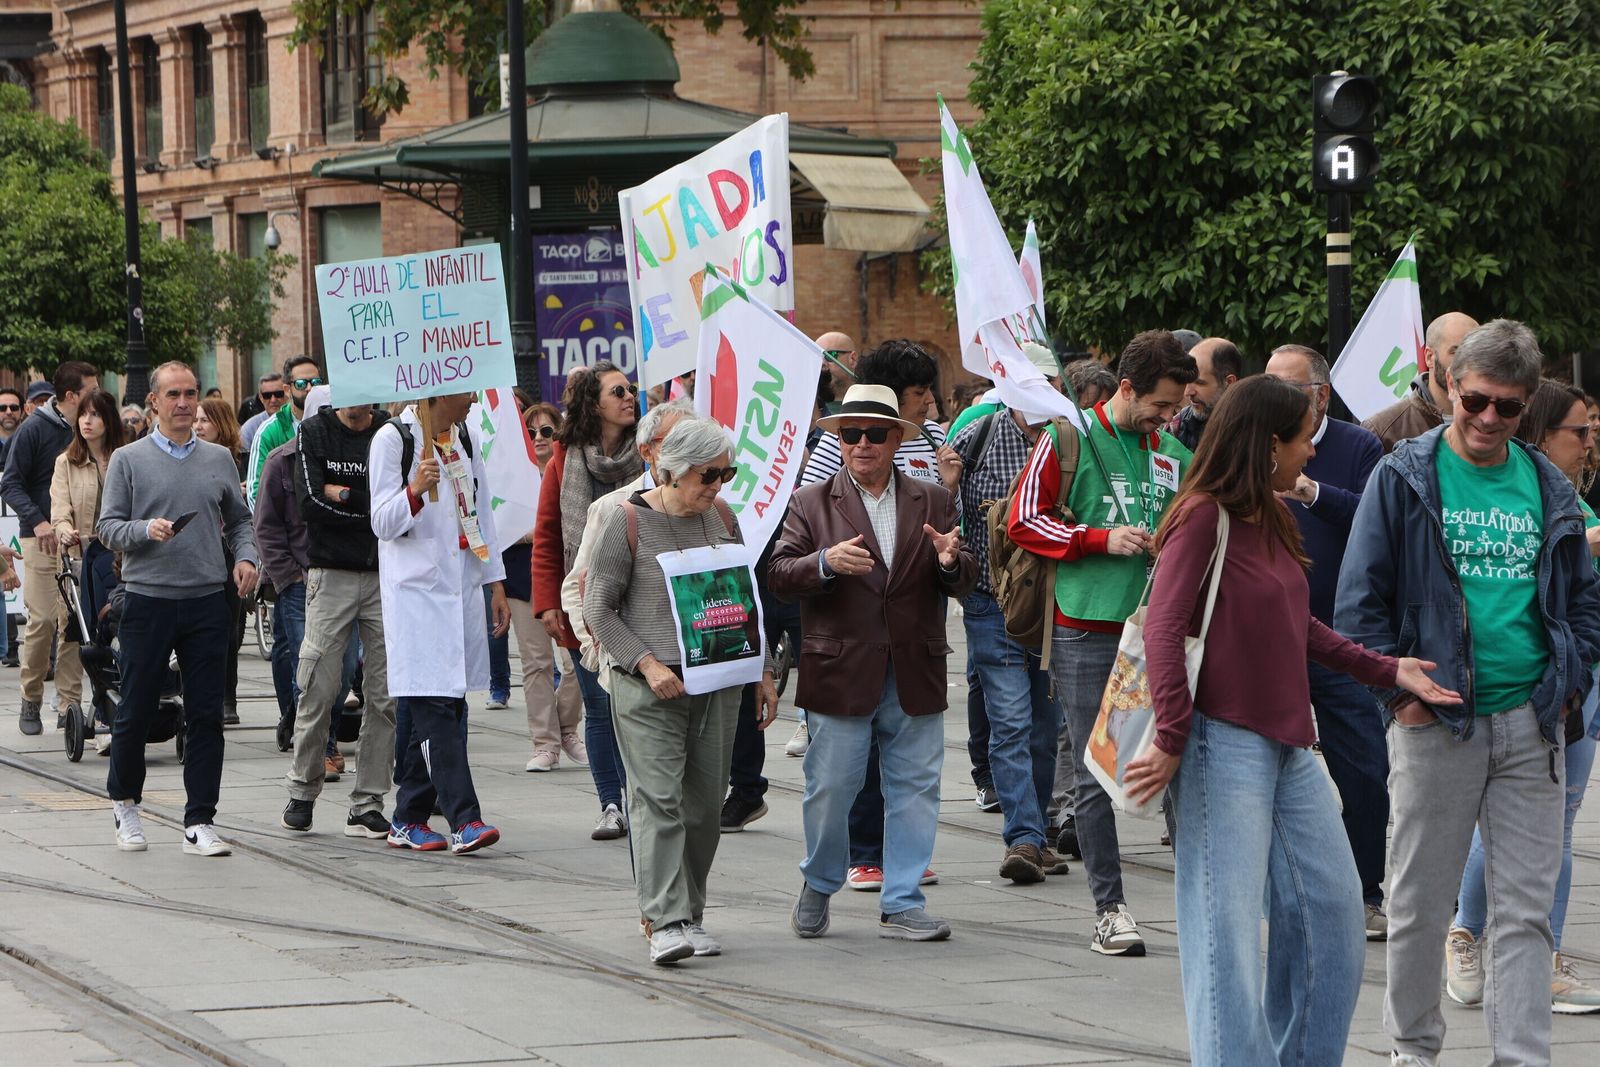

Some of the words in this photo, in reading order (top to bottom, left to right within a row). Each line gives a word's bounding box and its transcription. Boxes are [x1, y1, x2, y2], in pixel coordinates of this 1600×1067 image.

[539, 244, 581, 259] TACO
[353, 264, 391, 298] AULA
[395, 259, 420, 291] DE
[425, 252, 497, 287] INFANTIL
[347, 300, 395, 332] PARA
[422, 292, 460, 321] EL
[422, 320, 502, 354] MANUEL
[395, 355, 474, 393] ALONSO
[1154, 470, 1174, 482] USTEA
[1442, 509, 1498, 529] ESCUELA
[1452, 539, 1477, 555] DE
[693, 611, 705, 620] en
